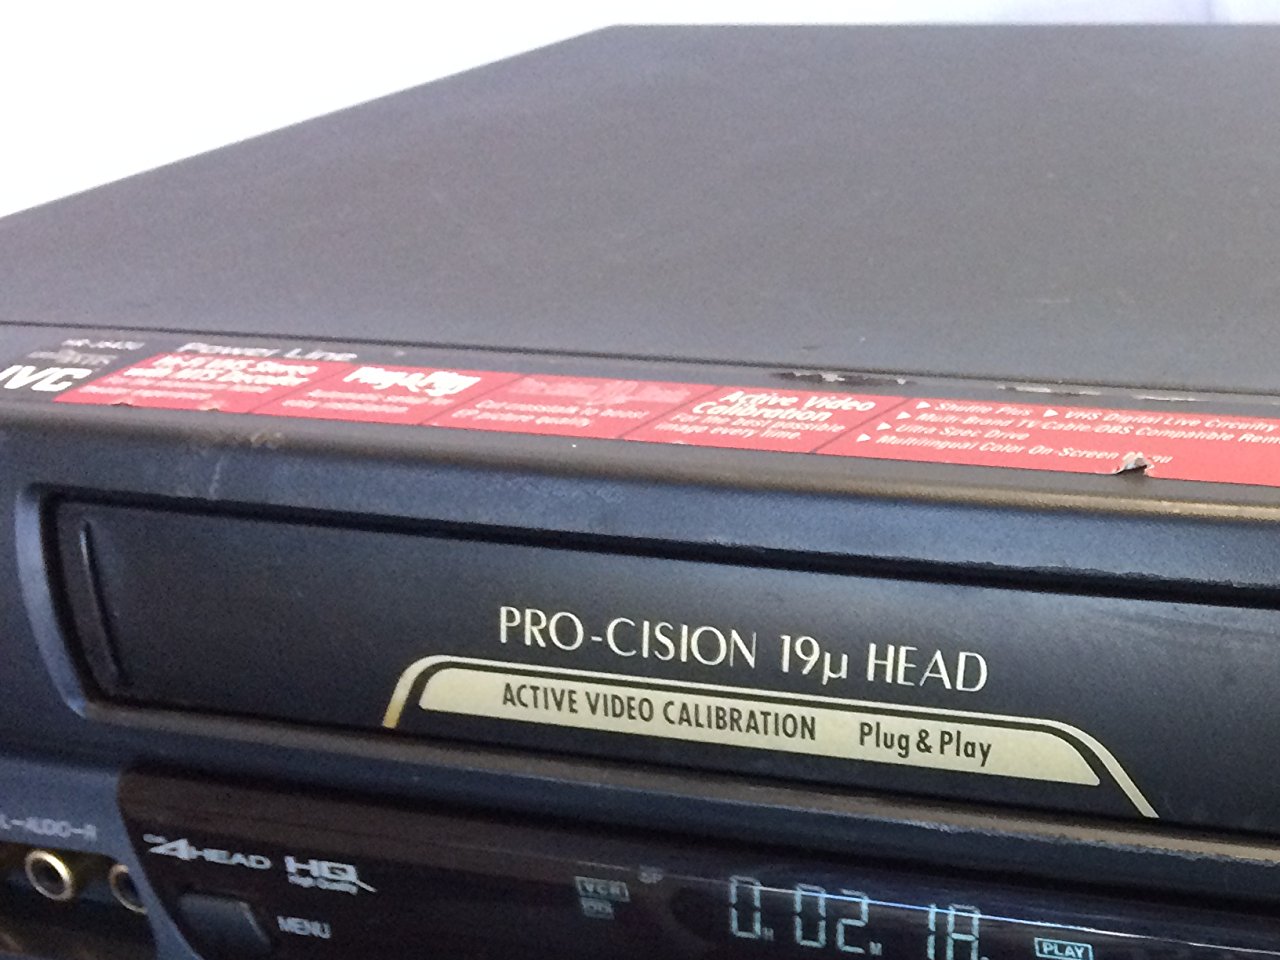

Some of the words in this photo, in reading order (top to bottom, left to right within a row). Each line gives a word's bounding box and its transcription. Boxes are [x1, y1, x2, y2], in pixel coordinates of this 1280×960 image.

[718, 391, 799, 406] Active
[803, 396, 876, 411] Video
[692, 402, 833, 421] Calibration
[994, 406, 1034, 417] Plus
[1064, 411, 1102, 421] VHS
[1103, 413, 1163, 424] Digital
[1163, 416, 1203, 427] Live
[983, 430, 1031, 441] Drive
[980, 442, 1026, 453] Color
[499, 605, 758, 670] PRO-CISION
[866, 642, 988, 692] HEAD
[502, 682, 579, 714] ACTIVE
[585, 691, 655, 722] VIDEO
[662, 700, 818, 741] CALIBRATION
[1042, 942, 1085, 960] PLAY
